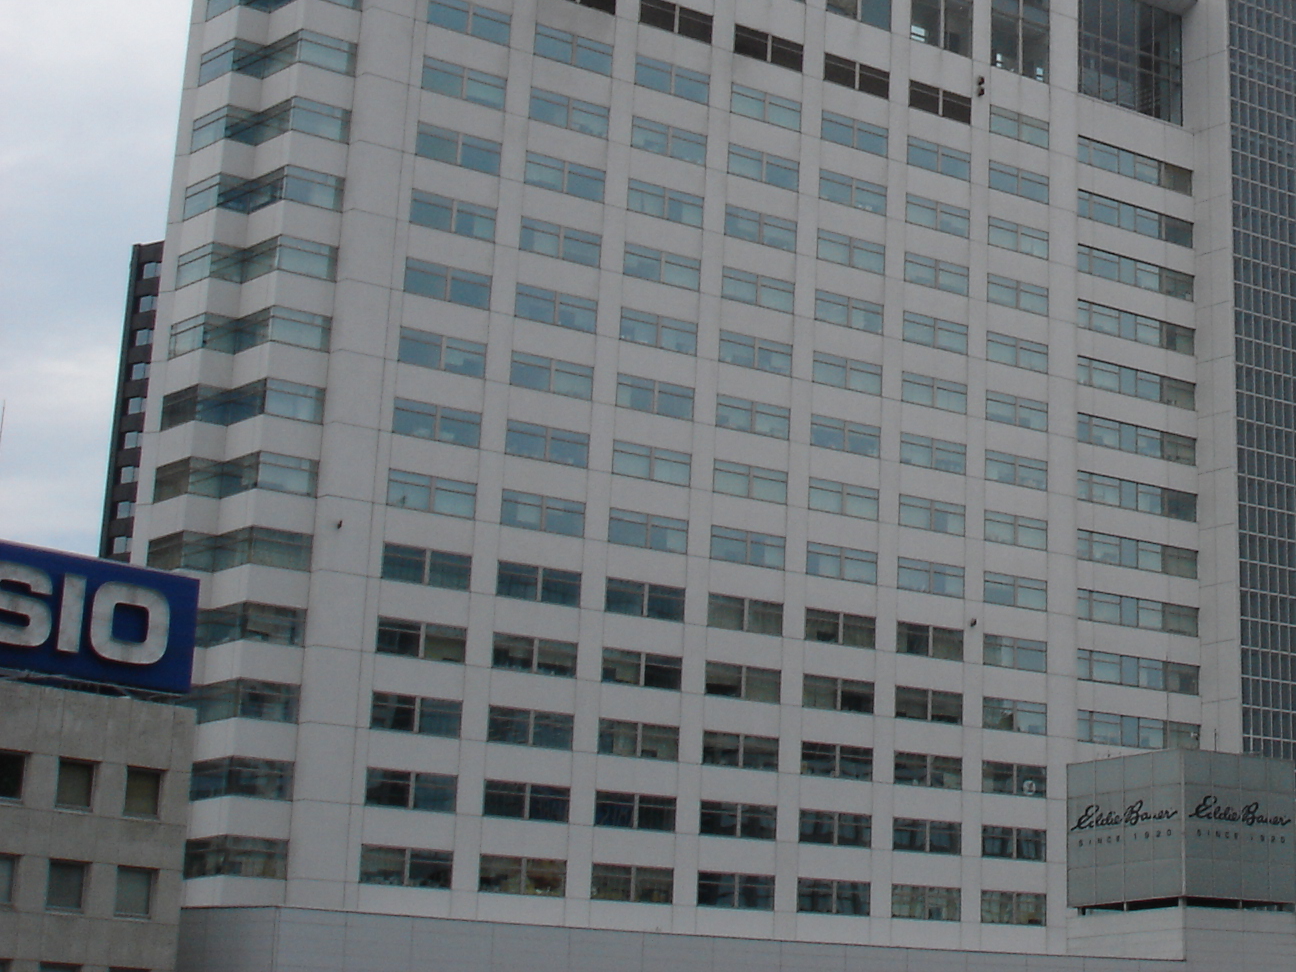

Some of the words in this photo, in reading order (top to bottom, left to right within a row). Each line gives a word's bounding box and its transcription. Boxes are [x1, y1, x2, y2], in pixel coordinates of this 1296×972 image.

[1070, 804, 1122, 831] Eddie
[1123, 799, 1179, 826] Bauer
[1188, 795, 1240, 822] Eddie
[1241, 801, 1292, 826] Bauer
[1078, 834, 1120, 848] SINCE
[1133, 828, 1172, 840] 1920
[1196, 828, 1239, 841] SINCE
